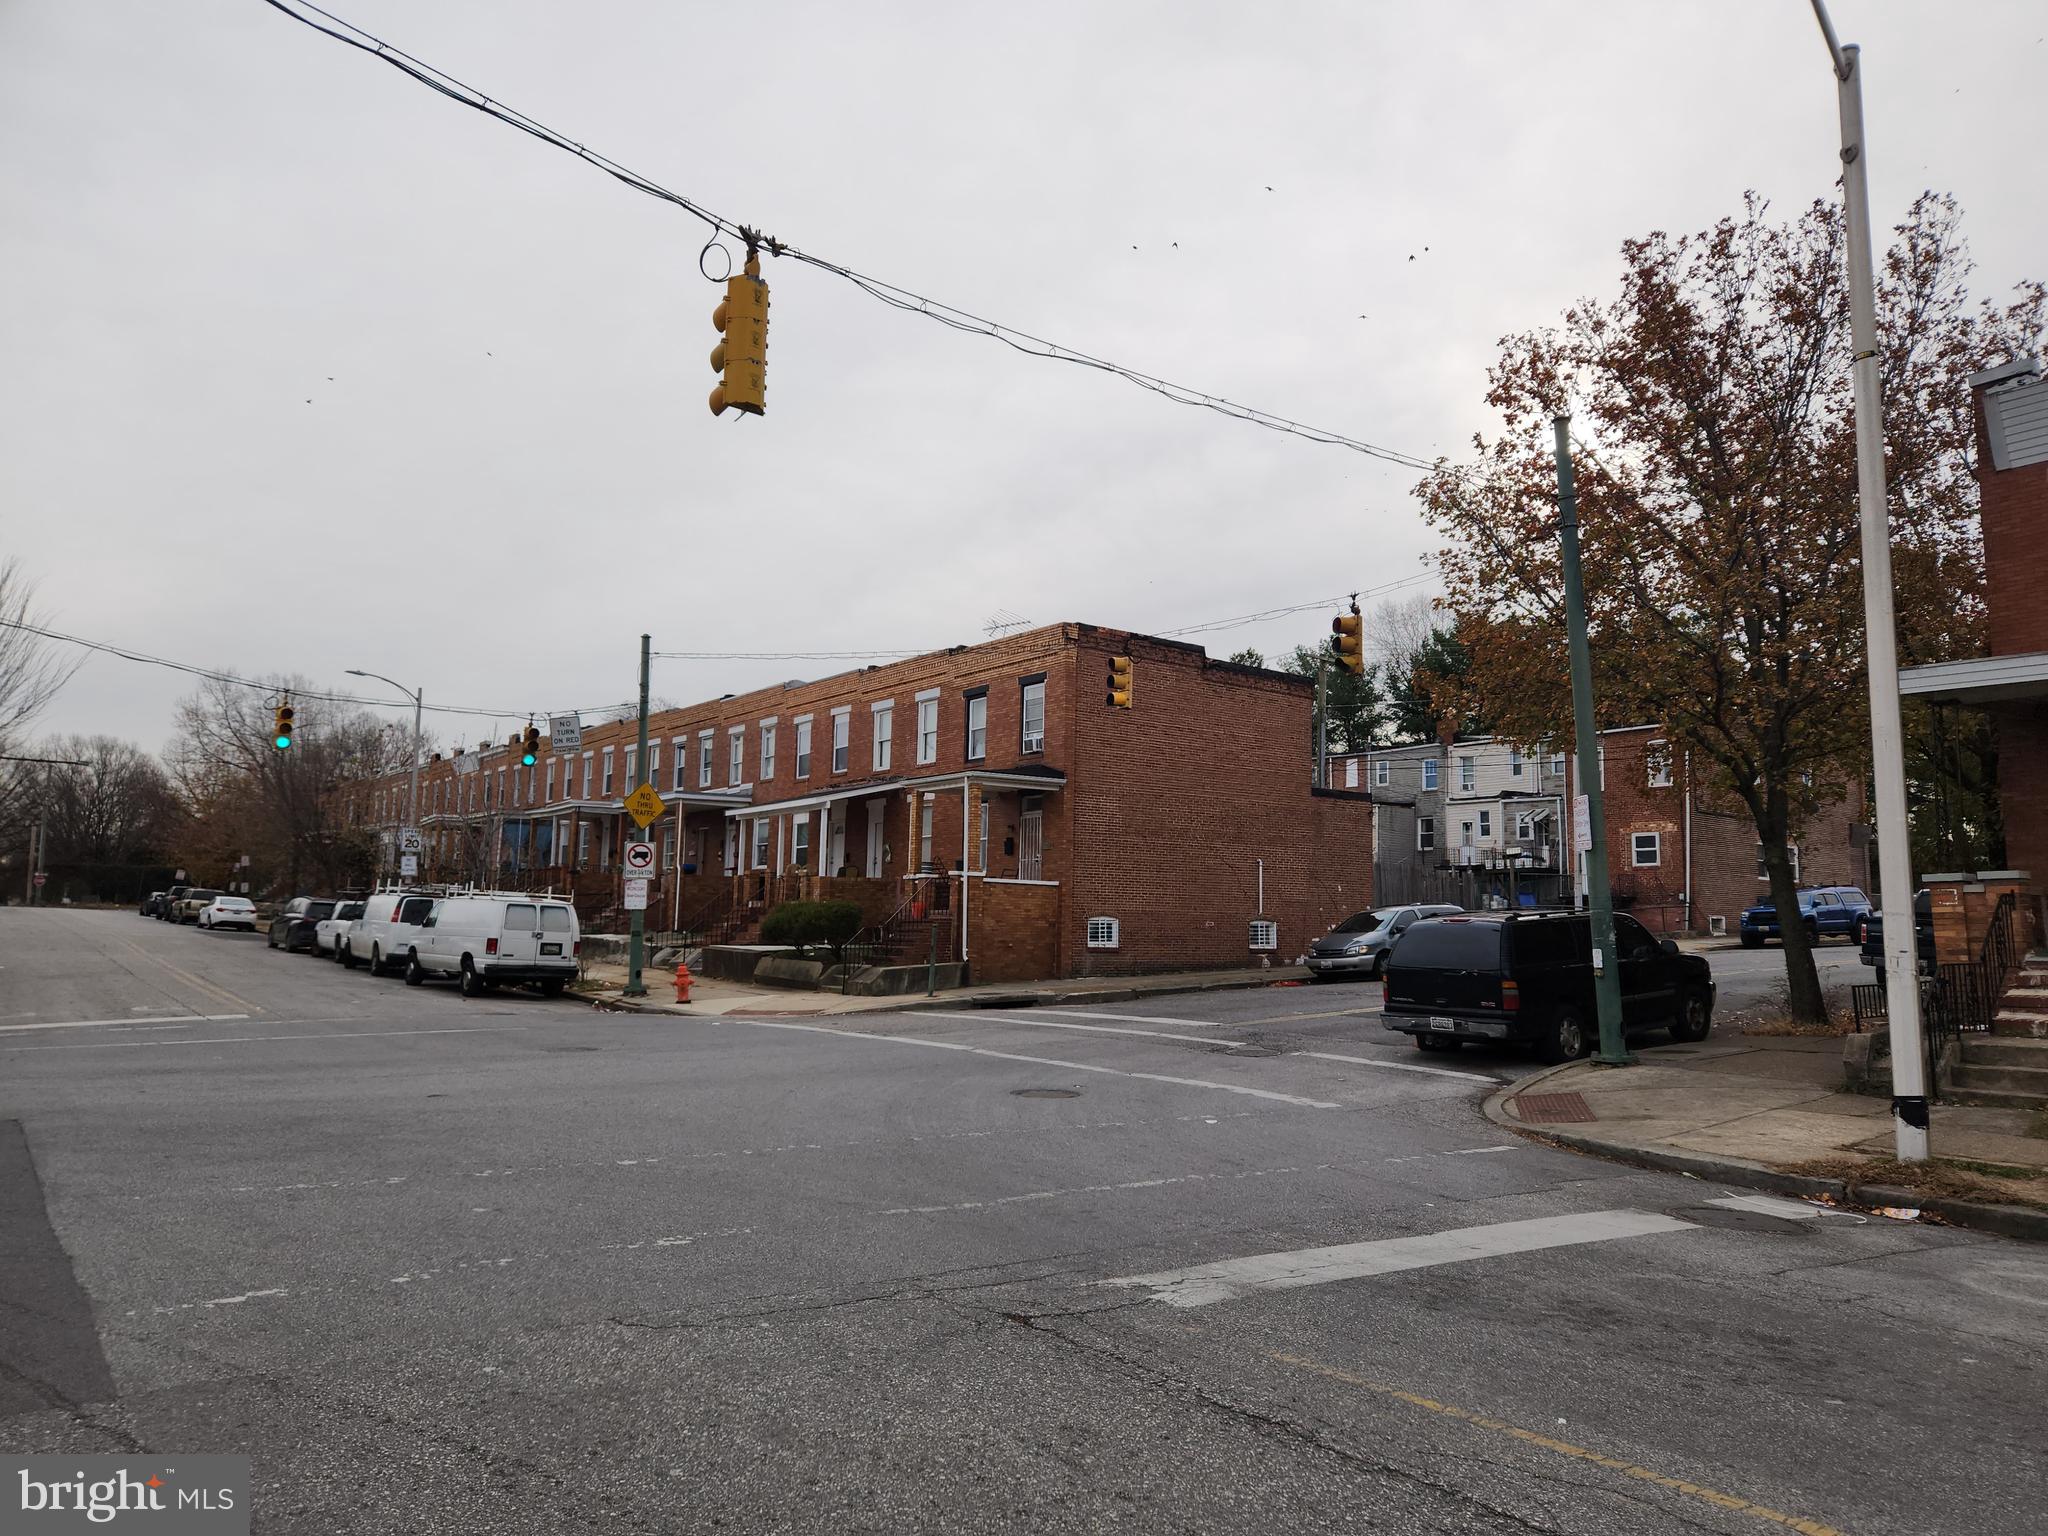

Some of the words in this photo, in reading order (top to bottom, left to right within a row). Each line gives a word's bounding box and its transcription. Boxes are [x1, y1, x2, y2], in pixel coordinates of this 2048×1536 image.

[637, 801, 654, 809] THRU
[632, 809, 656, 817] TRAFFIC
[404, 839, 420, 848] 20
